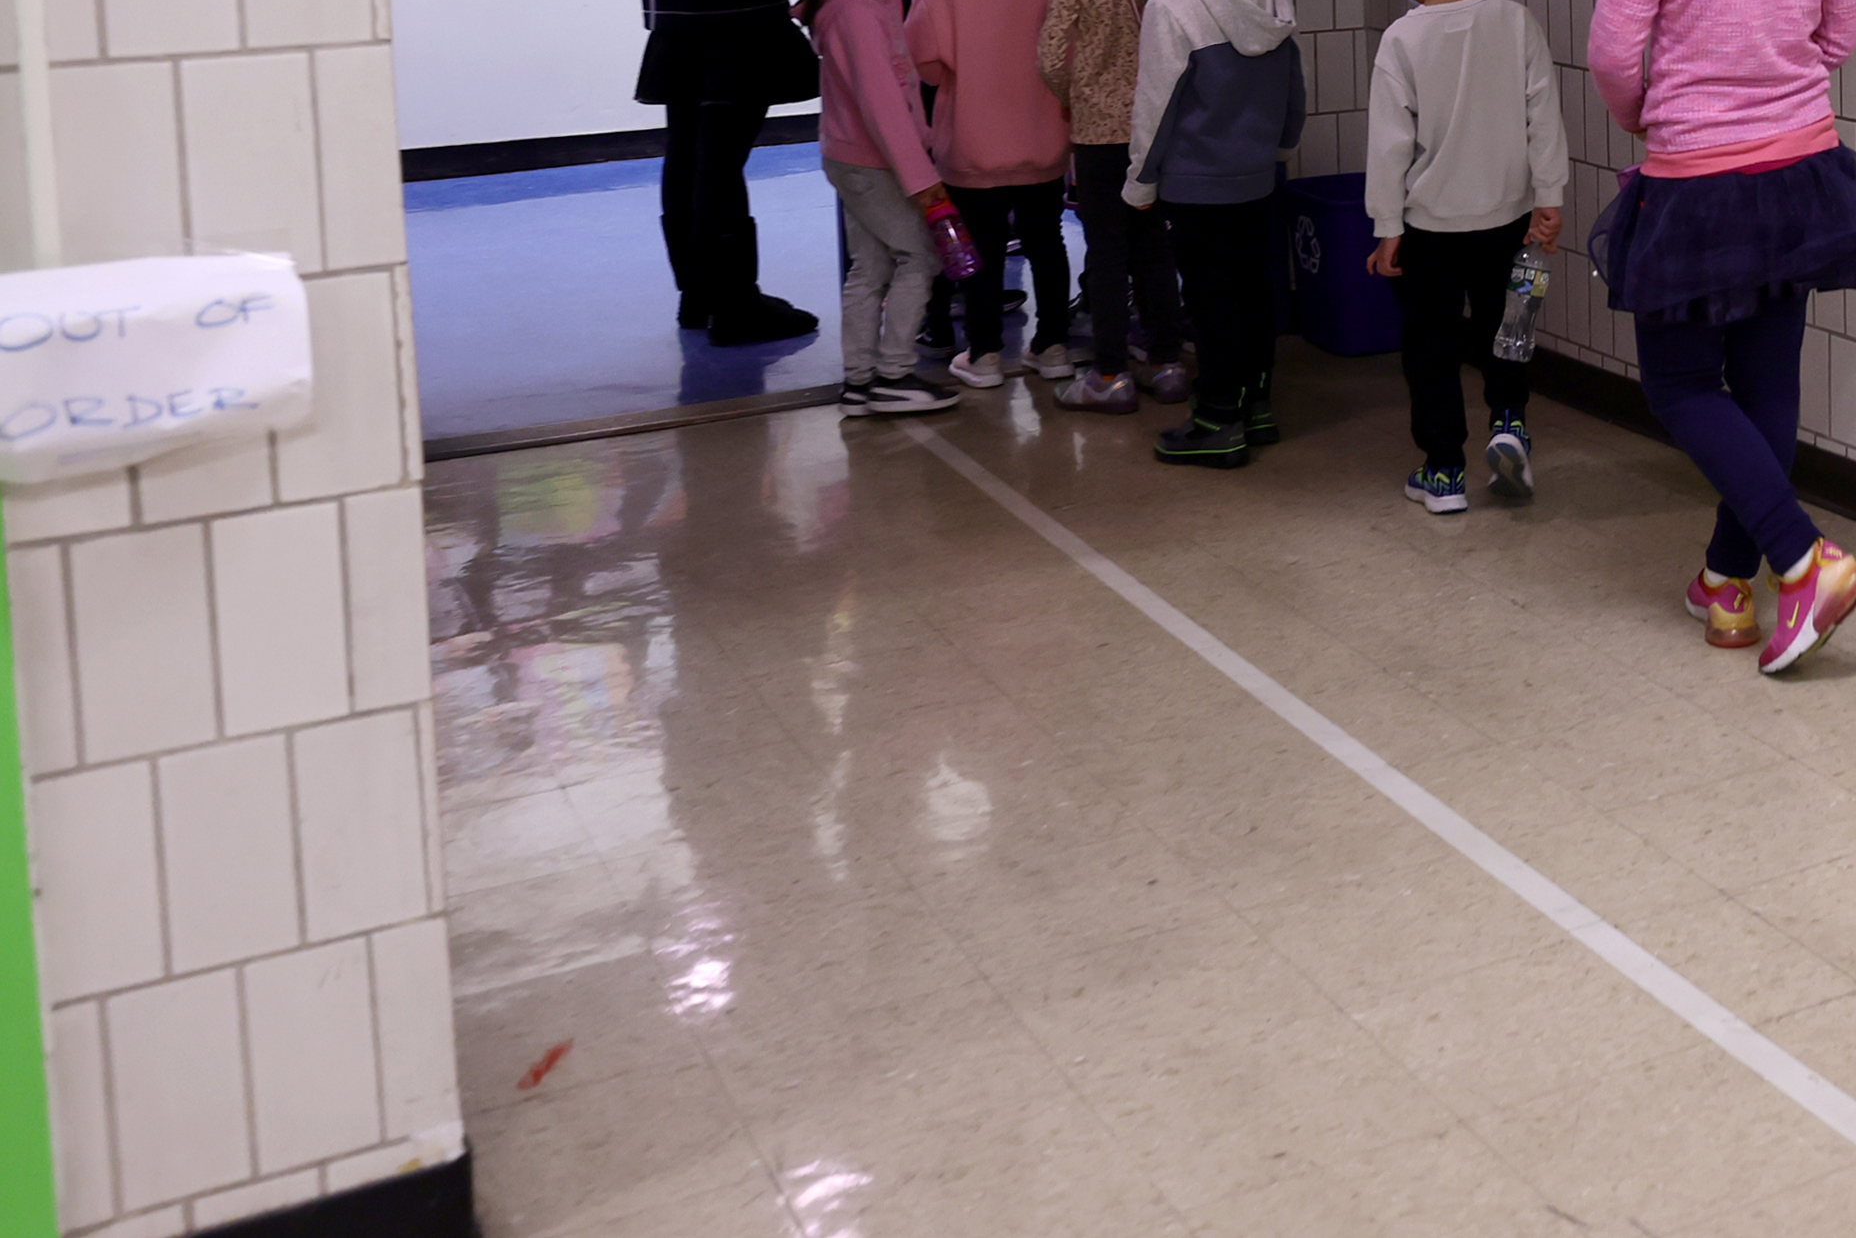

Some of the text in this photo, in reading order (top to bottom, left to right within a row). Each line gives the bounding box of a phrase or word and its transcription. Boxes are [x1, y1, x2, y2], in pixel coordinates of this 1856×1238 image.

[0, 294, 276, 352] OUT OF
[0, 387, 260, 441] ORDER
